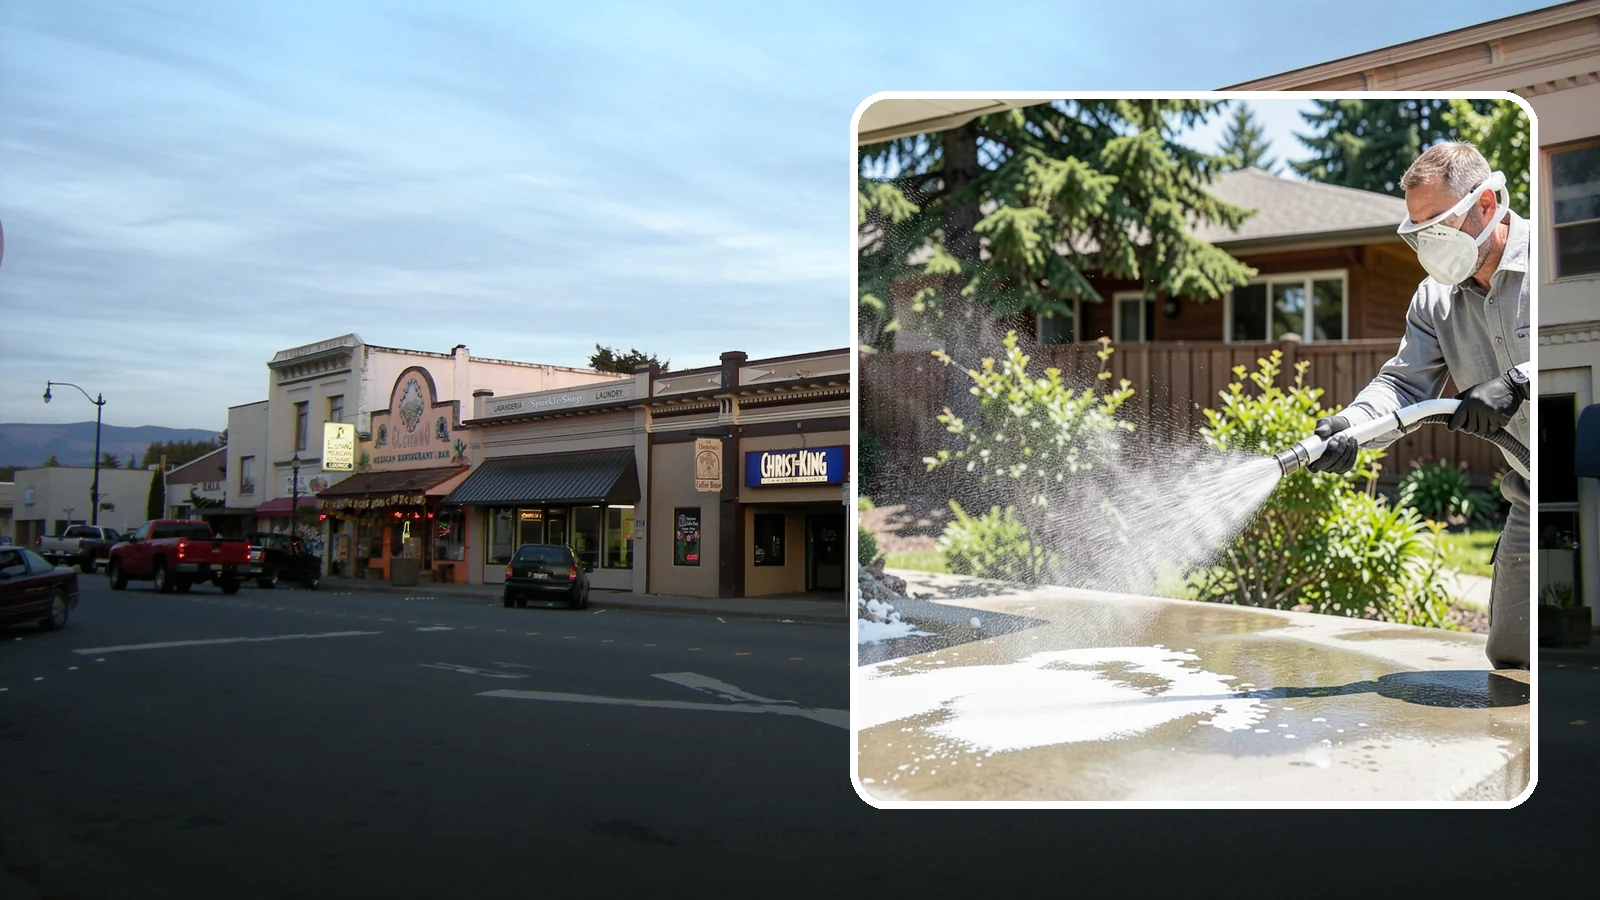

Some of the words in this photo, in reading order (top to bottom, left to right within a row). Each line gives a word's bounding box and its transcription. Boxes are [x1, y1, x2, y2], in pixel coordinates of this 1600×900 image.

[595, 389, 623, 400] LAUNDRY
[493, 402, 522, 413] LAVANDERIA
[530, 397, 561, 409] Sparkle
[562, 395, 582, 405] Shop
[391, 425, 402, 449] EL
[402, 421, 431, 449] GITANO
[373, 455, 396, 464] MEXICAN
[397, 451, 433, 462] RESTAURANT
[438, 450, 450, 459] BAR
[761, 452, 797, 478] CHRIST
[799, 450, 827, 476] KING
[696, 480, 709, 489] Coffee
